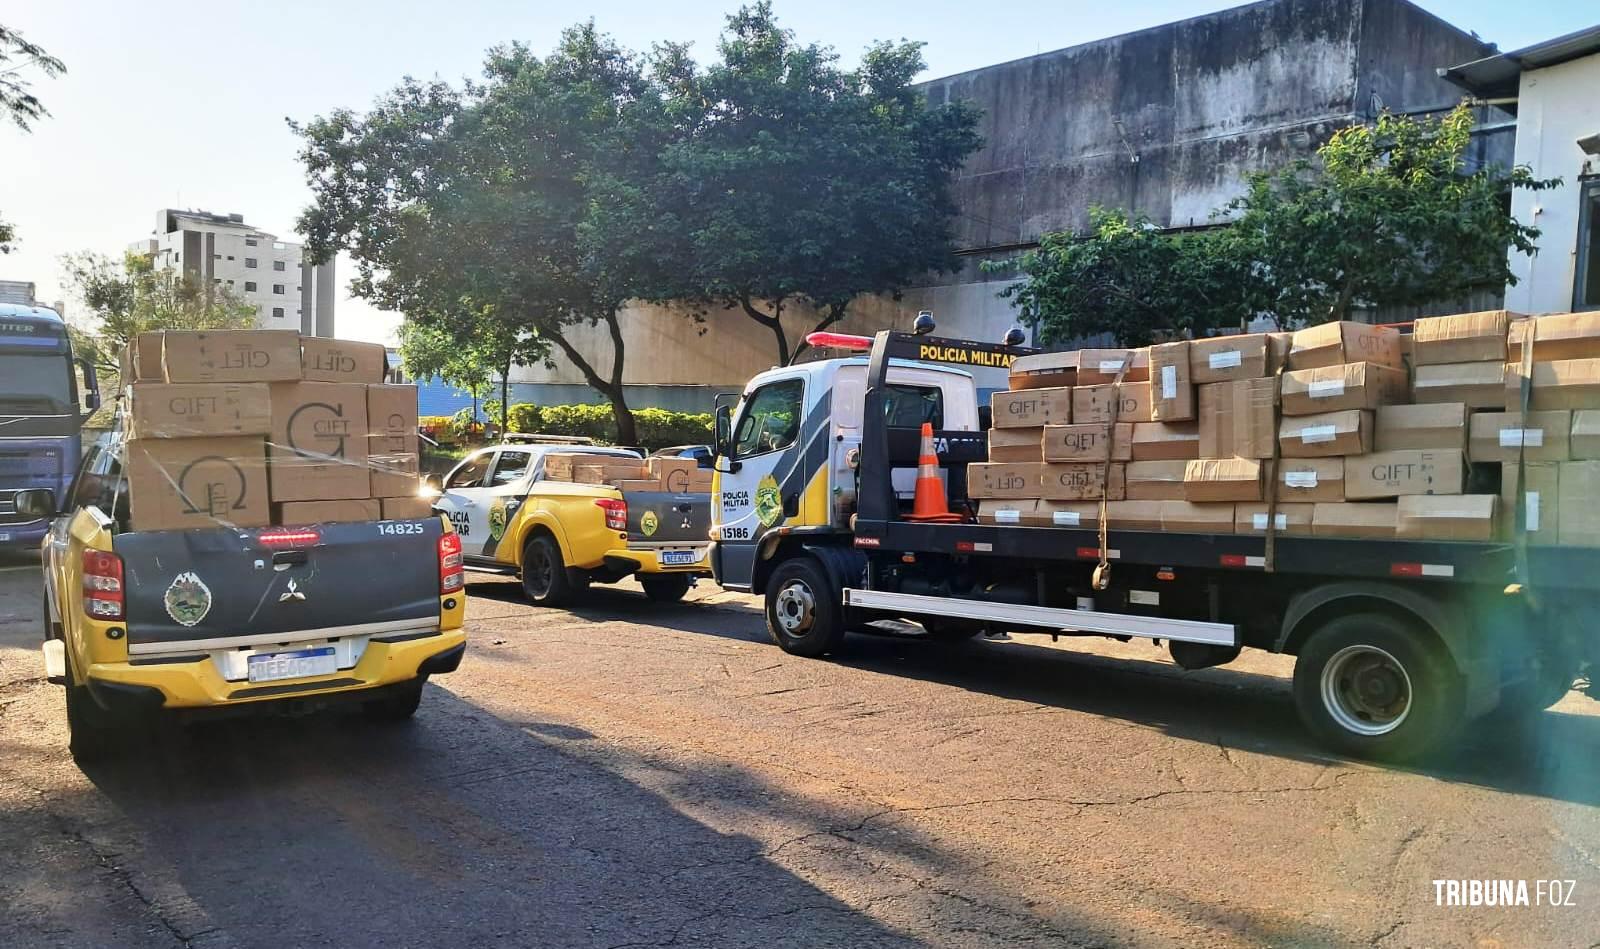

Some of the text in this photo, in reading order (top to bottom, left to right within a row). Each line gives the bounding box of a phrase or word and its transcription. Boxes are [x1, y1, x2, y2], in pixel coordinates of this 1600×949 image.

[219, 350, 270, 369] GIFT
[312, 354, 356, 373] GIFT
[169, 397, 217, 415] GIFT
[1009, 400, 1037, 415] GIFT
[313, 419, 352, 435] GIFT
[1064, 433, 1096, 448] GIFT
[1371, 463, 1416, 481] GIFT
[723, 499, 749, 508] MILITAR
[377, 522, 424, 536] 14825
[723, 527, 749, 539] 15186
